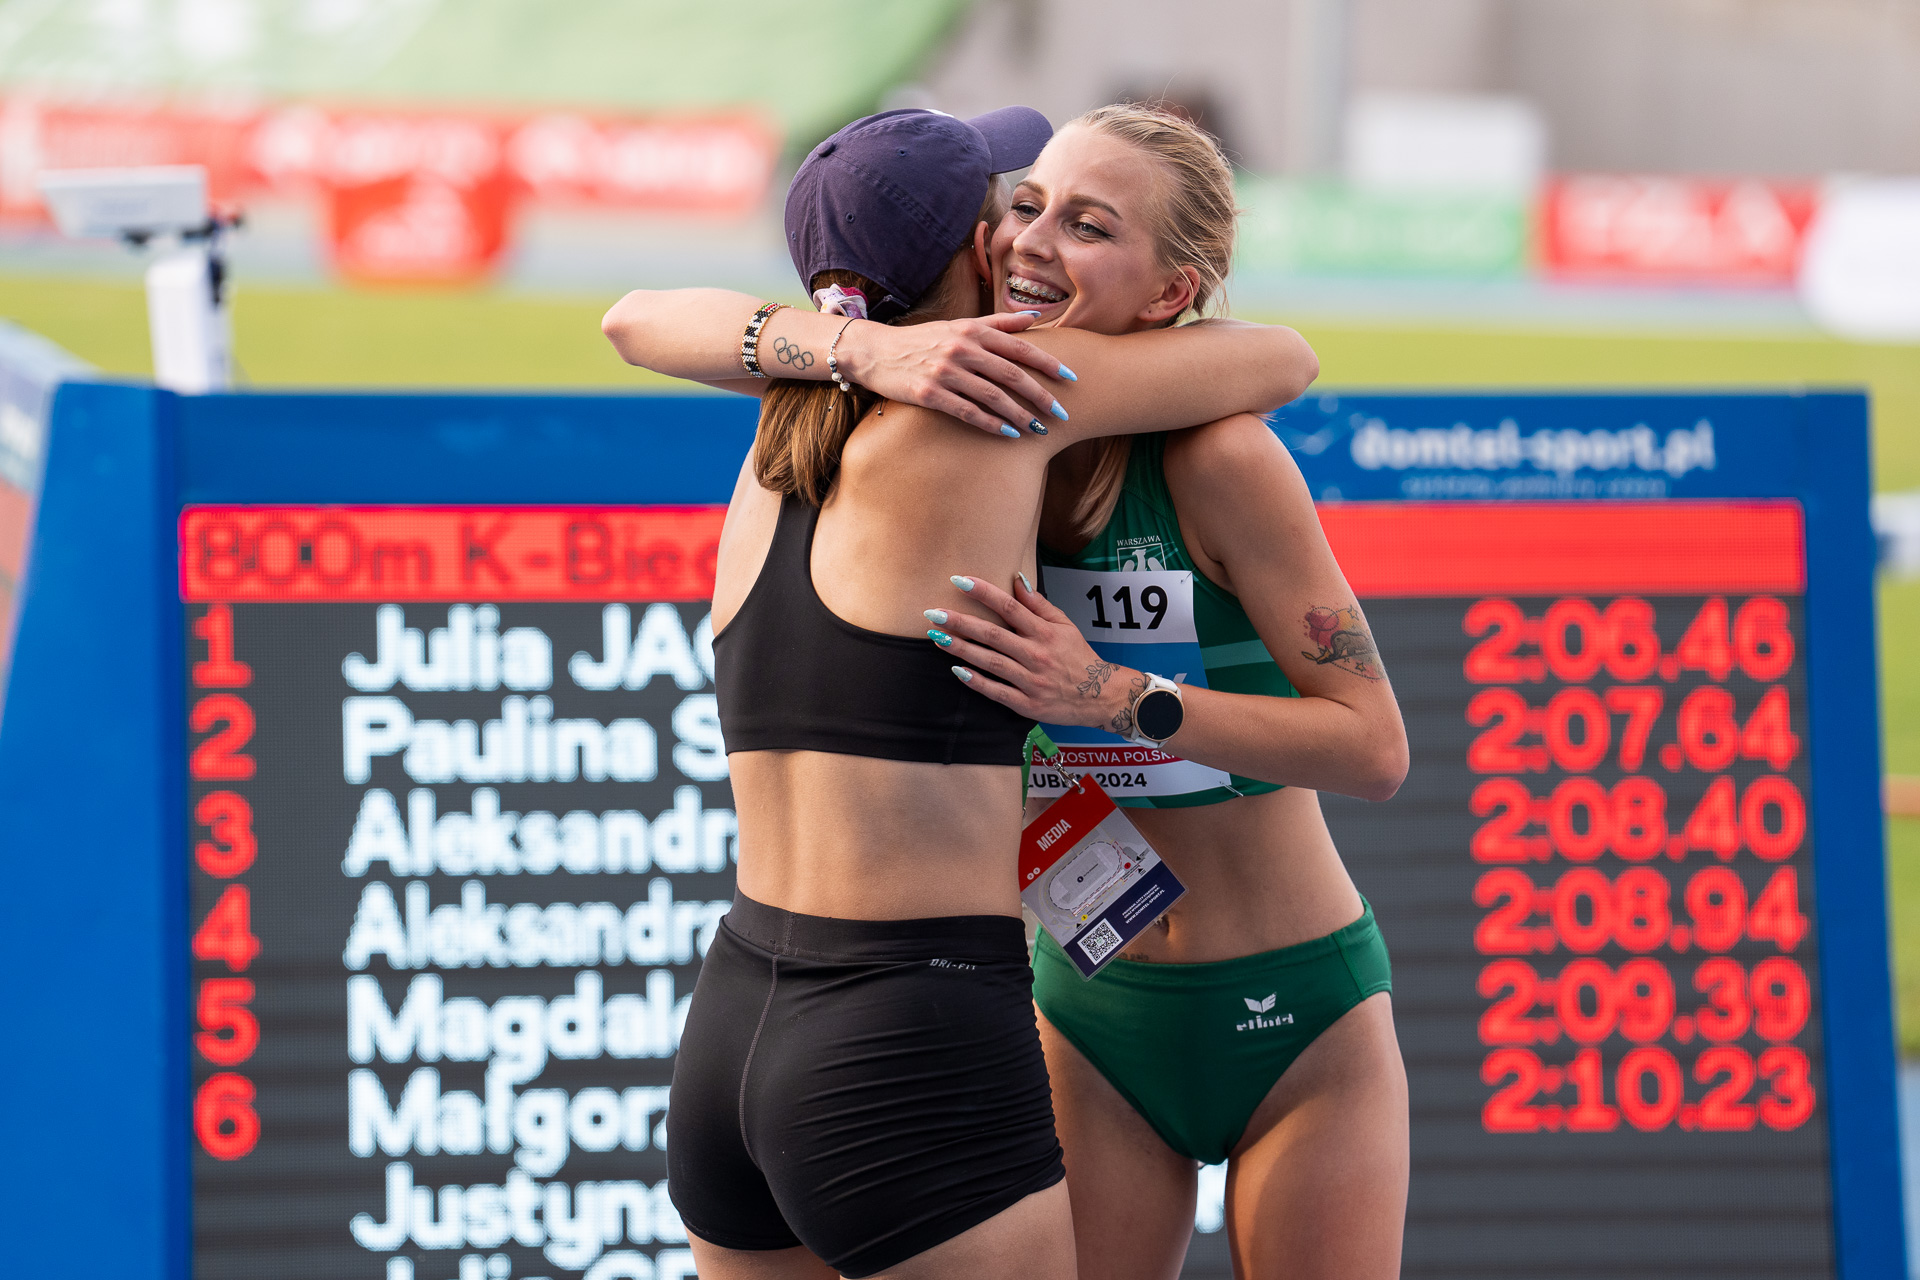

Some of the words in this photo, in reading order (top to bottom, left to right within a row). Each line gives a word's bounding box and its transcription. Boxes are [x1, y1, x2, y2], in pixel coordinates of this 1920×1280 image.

[200, 521, 432, 584] 800m
[1117, 535, 1161, 547] WARSZAWA
[1086, 585, 1168, 630] 119
[192, 602, 254, 688] 1
[342, 603, 553, 691] Julia
[568, 602, 716, 691] JA
[1462, 596, 1796, 683] 2:06.46
[189, 693, 257, 781] 2
[342, 694, 658, 784] Paulina
[1466, 684, 1802, 774] 2:07.64
[1124, 749, 1175, 763] POLSK
[1096, 772, 1147, 788] 2024
[194, 790, 258, 878] 3
[341, 785, 739, 877] Aleksandr
[1469, 774, 1807, 863] 2:08.40
[1036, 819, 1072, 852] MEDIA
[192, 883, 261, 972] 4
[1472, 865, 1811, 954] 2:08.94
[929, 958, 976, 971] DRI-FIT
[192, 977, 260, 1066] 5
[1476, 956, 1812, 1046] 2:09.39
[192, 1072, 261, 1161] 6
[1480, 1045, 1817, 1134] 2:10.23
